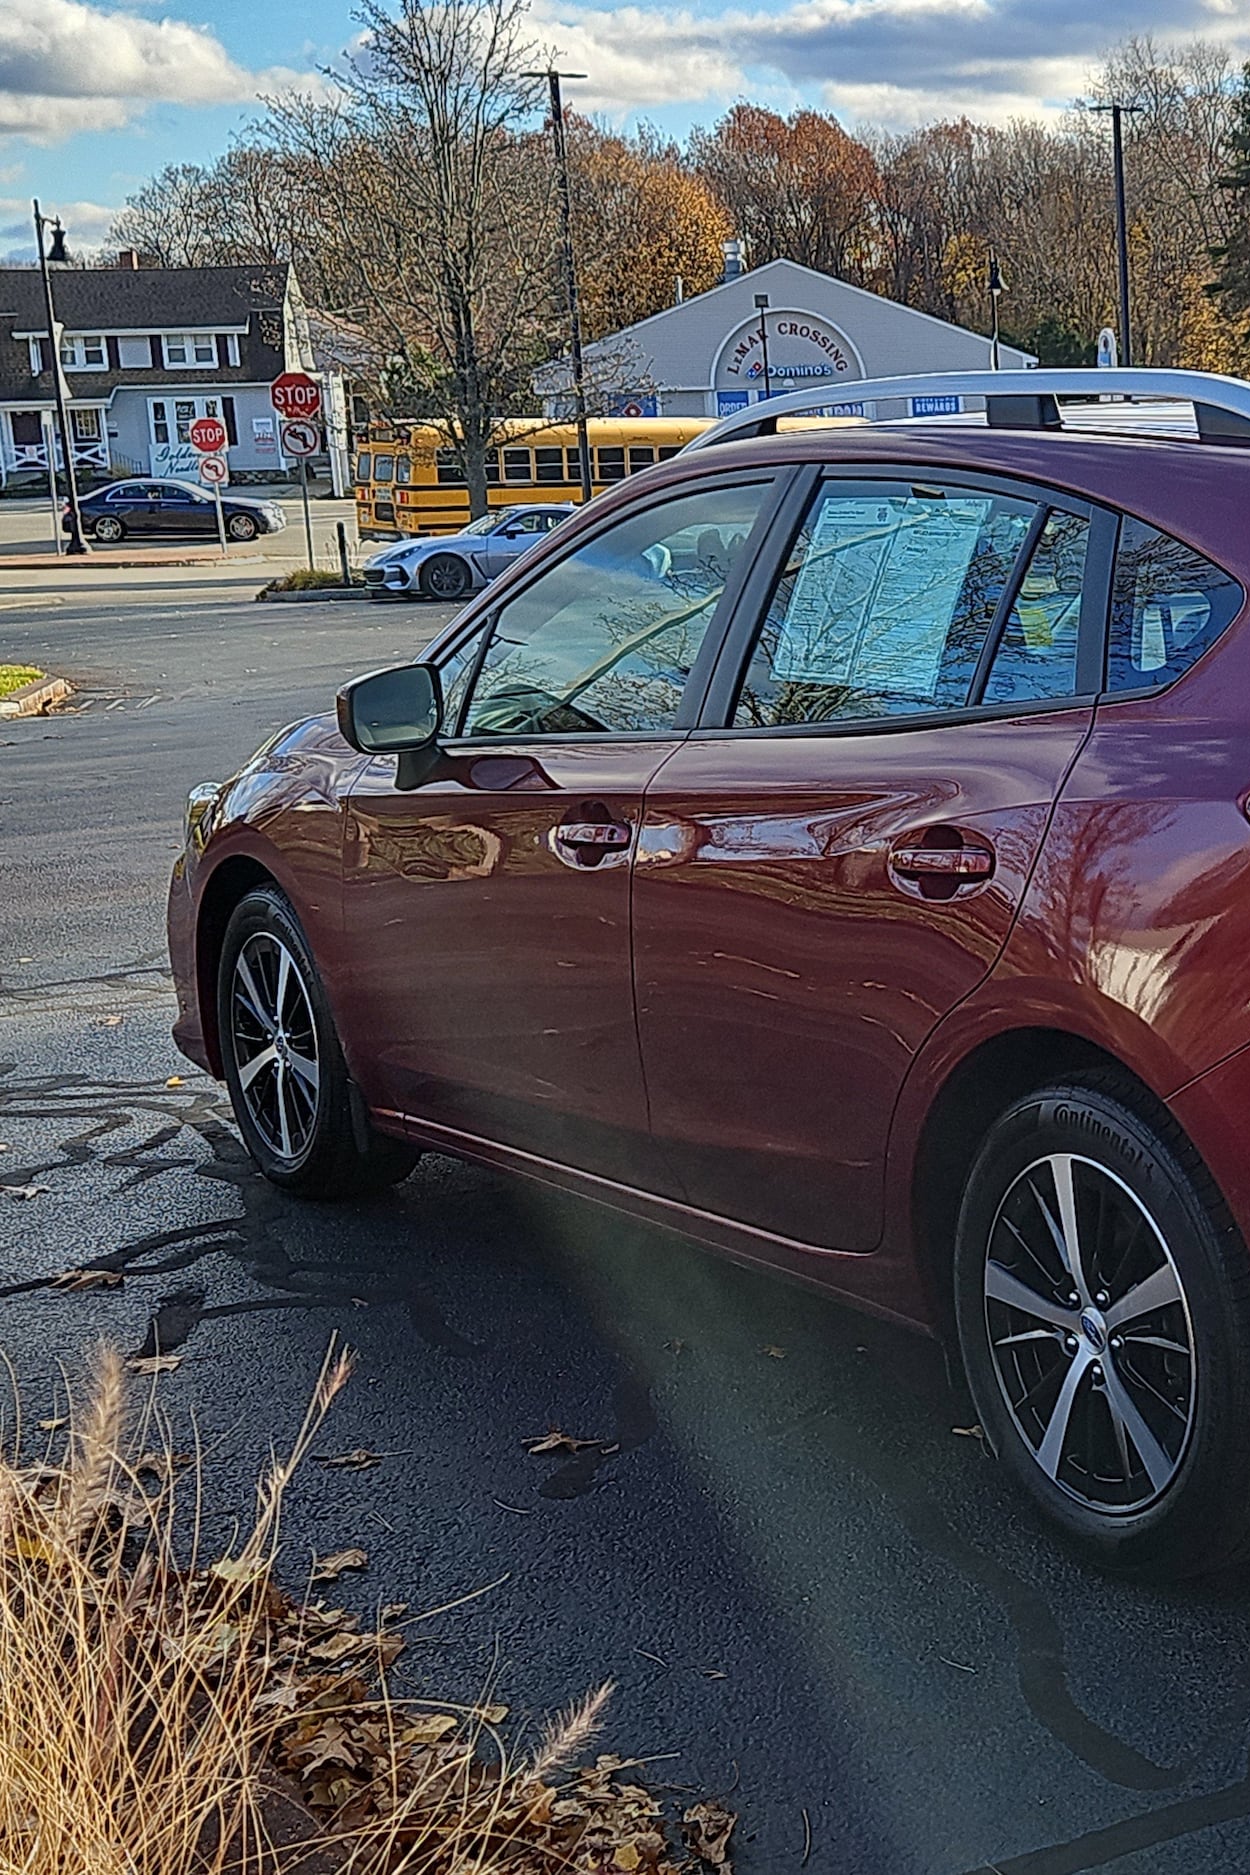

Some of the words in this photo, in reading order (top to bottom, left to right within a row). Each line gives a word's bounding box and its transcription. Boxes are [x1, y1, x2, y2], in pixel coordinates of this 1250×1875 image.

[777, 322, 849, 372] CROSSING
[767, 363, 832, 377] Domino's
[274, 386, 317, 405] STOP
[915, 402, 956, 413] REWARDS
[192, 428, 223, 444] STOP
[1053, 1103, 1144, 1165] Continental
